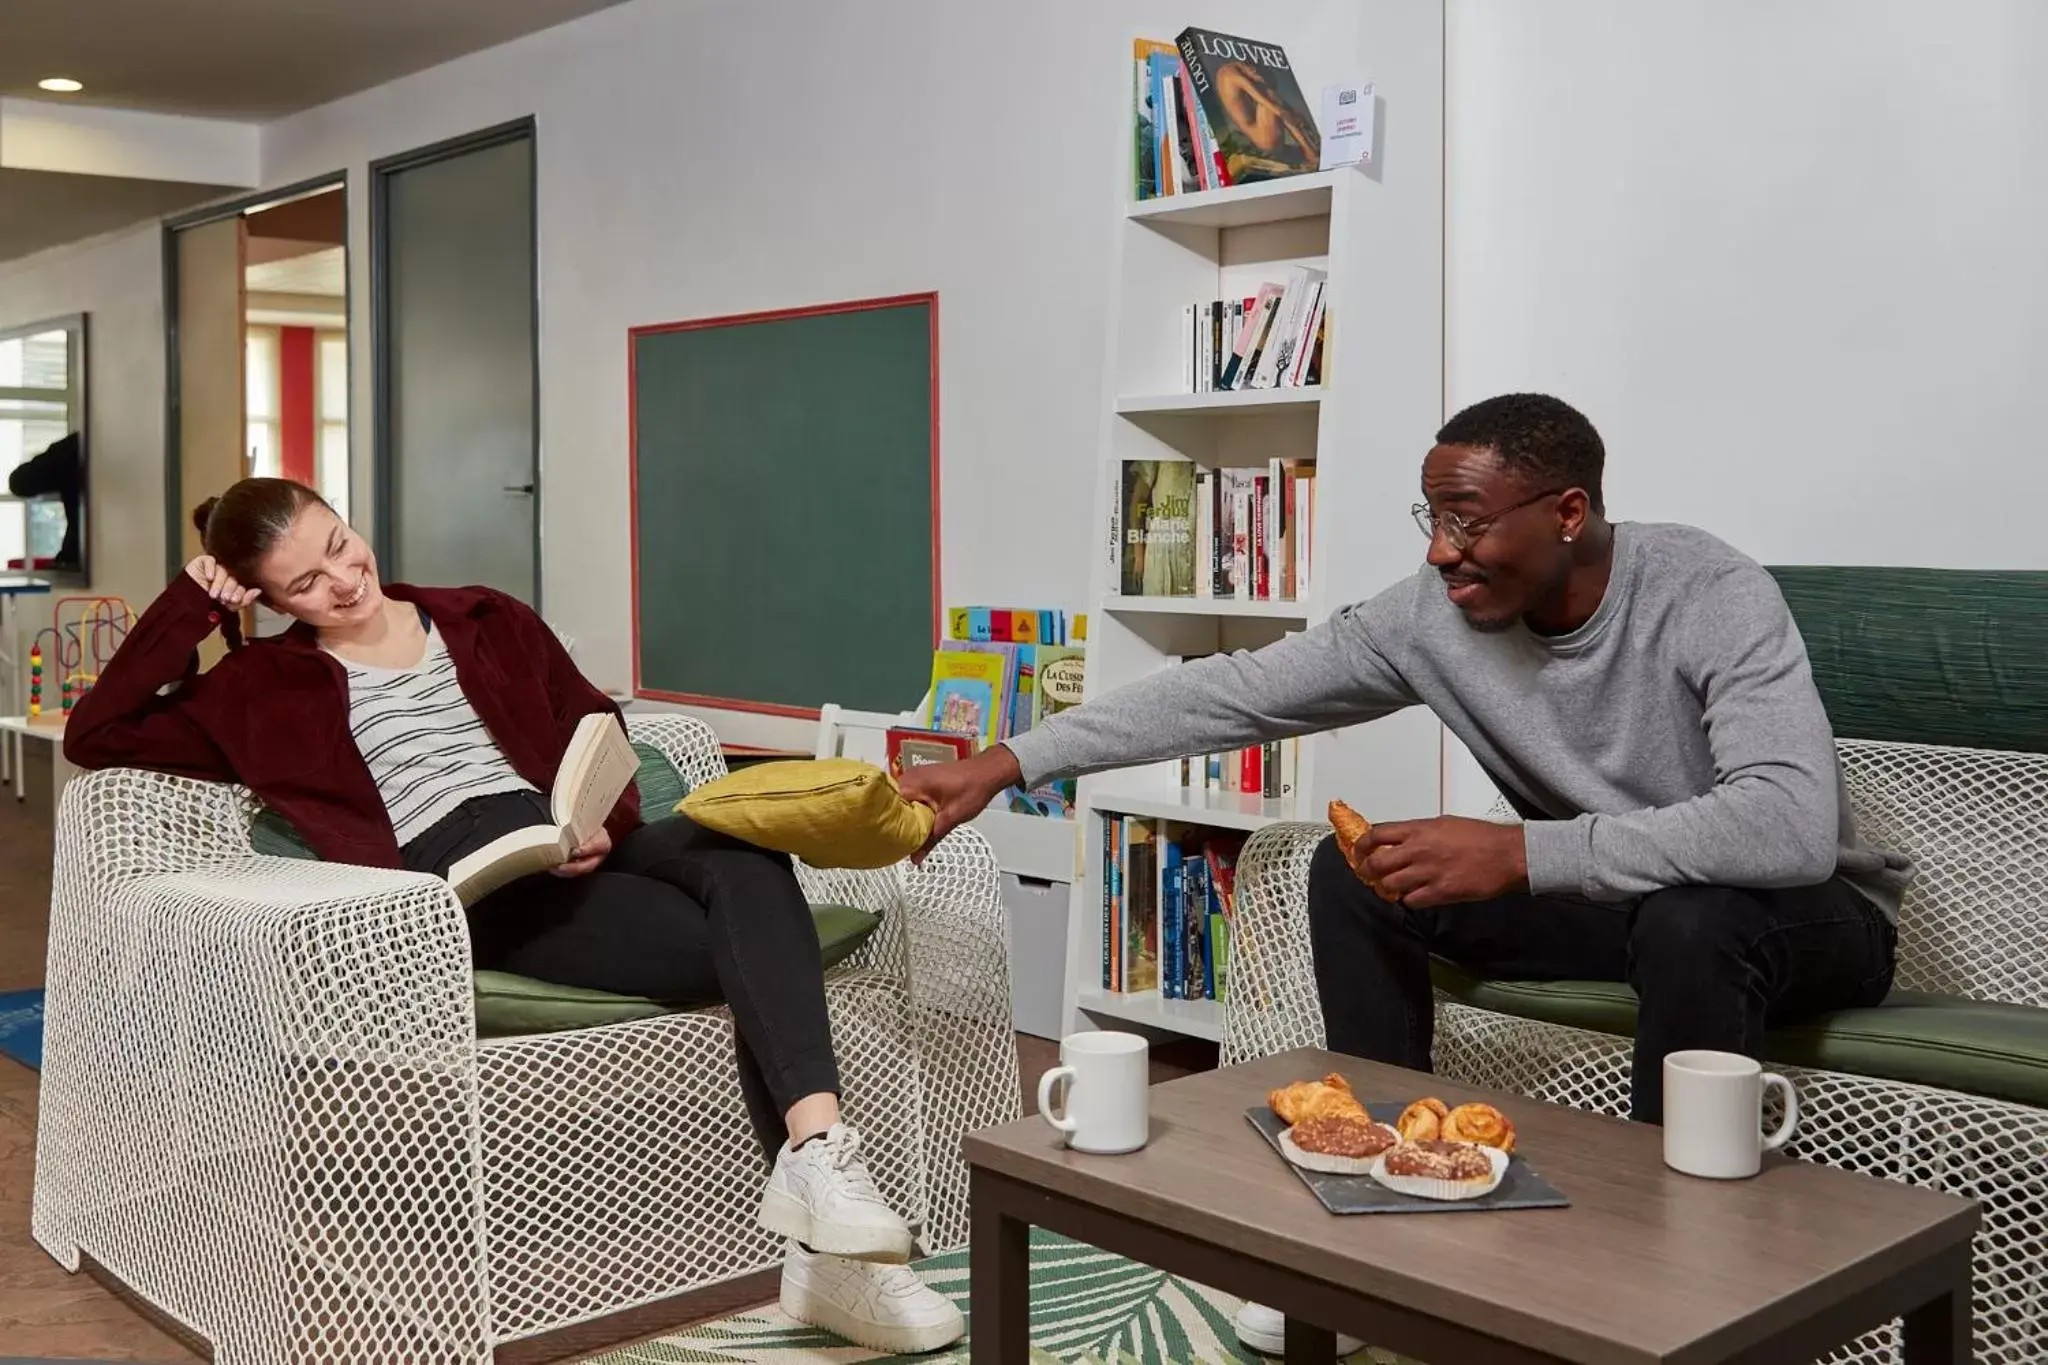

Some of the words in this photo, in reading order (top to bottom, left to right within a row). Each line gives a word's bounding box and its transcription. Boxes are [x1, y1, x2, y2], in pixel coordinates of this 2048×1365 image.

[1197, 34, 1290, 69] LOUVRE
[1181, 36, 1210, 94] LOUVRE
[1162, 494, 1190, 510] Jim
[1136, 502, 1190, 520] Fergus
[1146, 516, 1190, 531] Marie
[1127, 529, 1190, 545] Blanche
